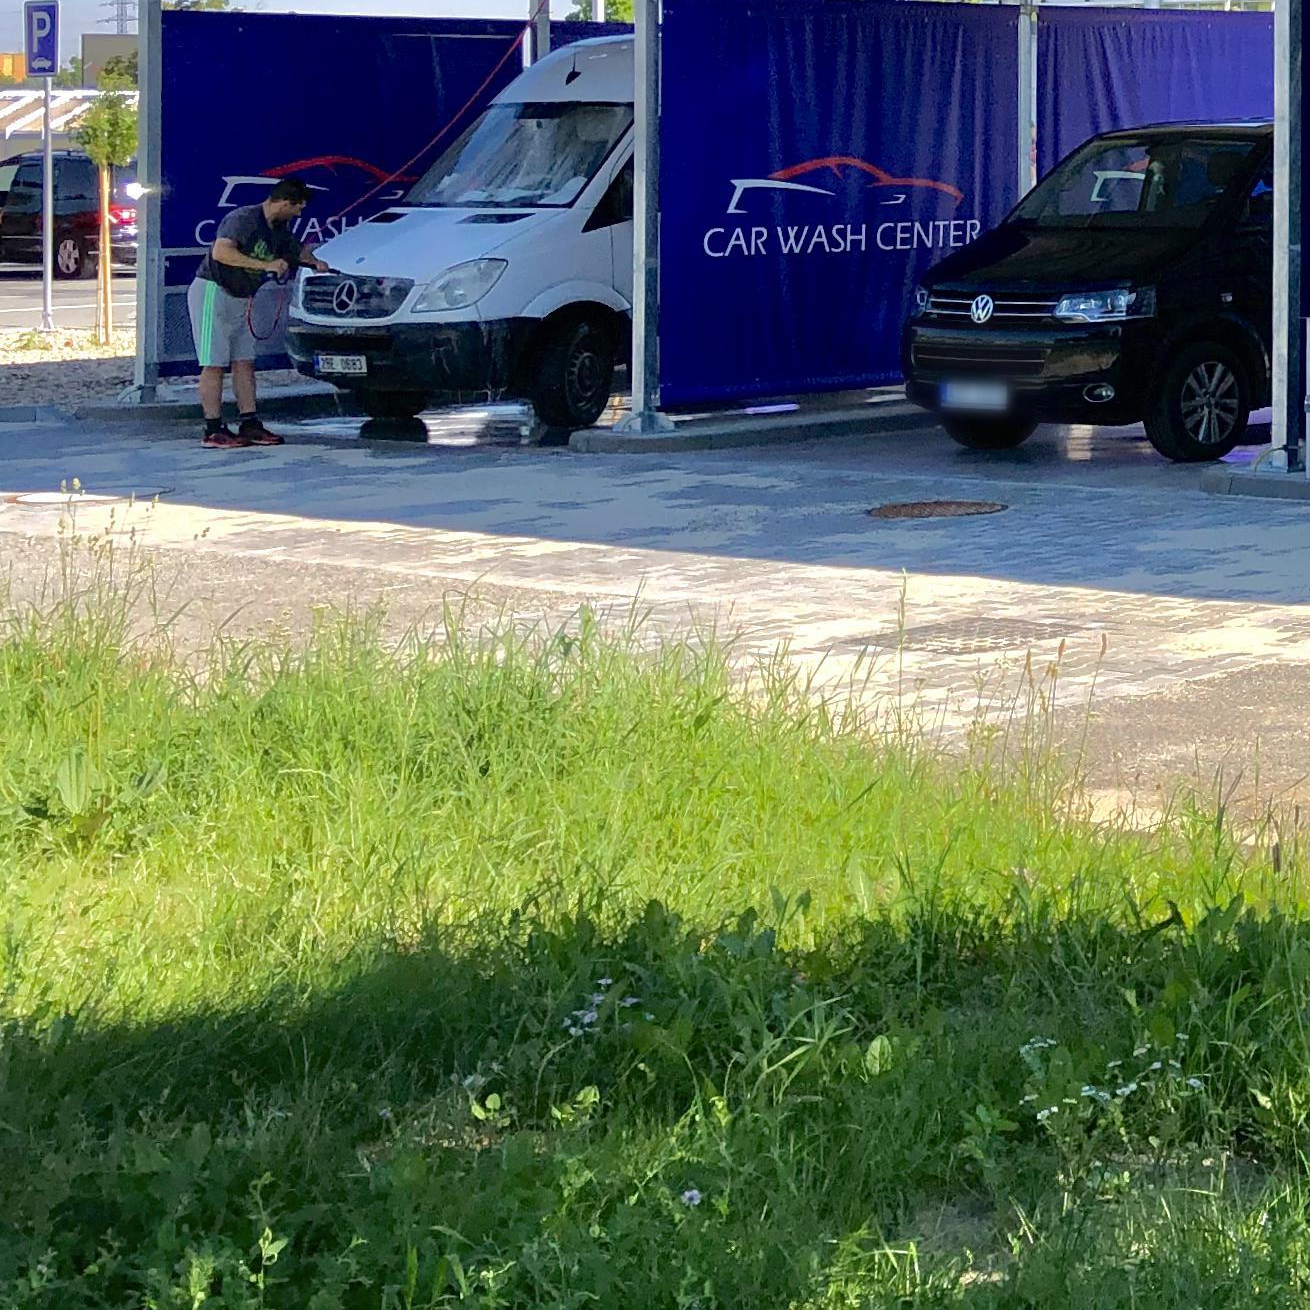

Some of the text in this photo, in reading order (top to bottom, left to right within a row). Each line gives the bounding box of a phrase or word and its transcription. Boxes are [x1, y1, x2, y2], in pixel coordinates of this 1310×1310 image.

[32, 11, 51, 53] P
[703, 219, 981, 257] CAR WASH CENTER
